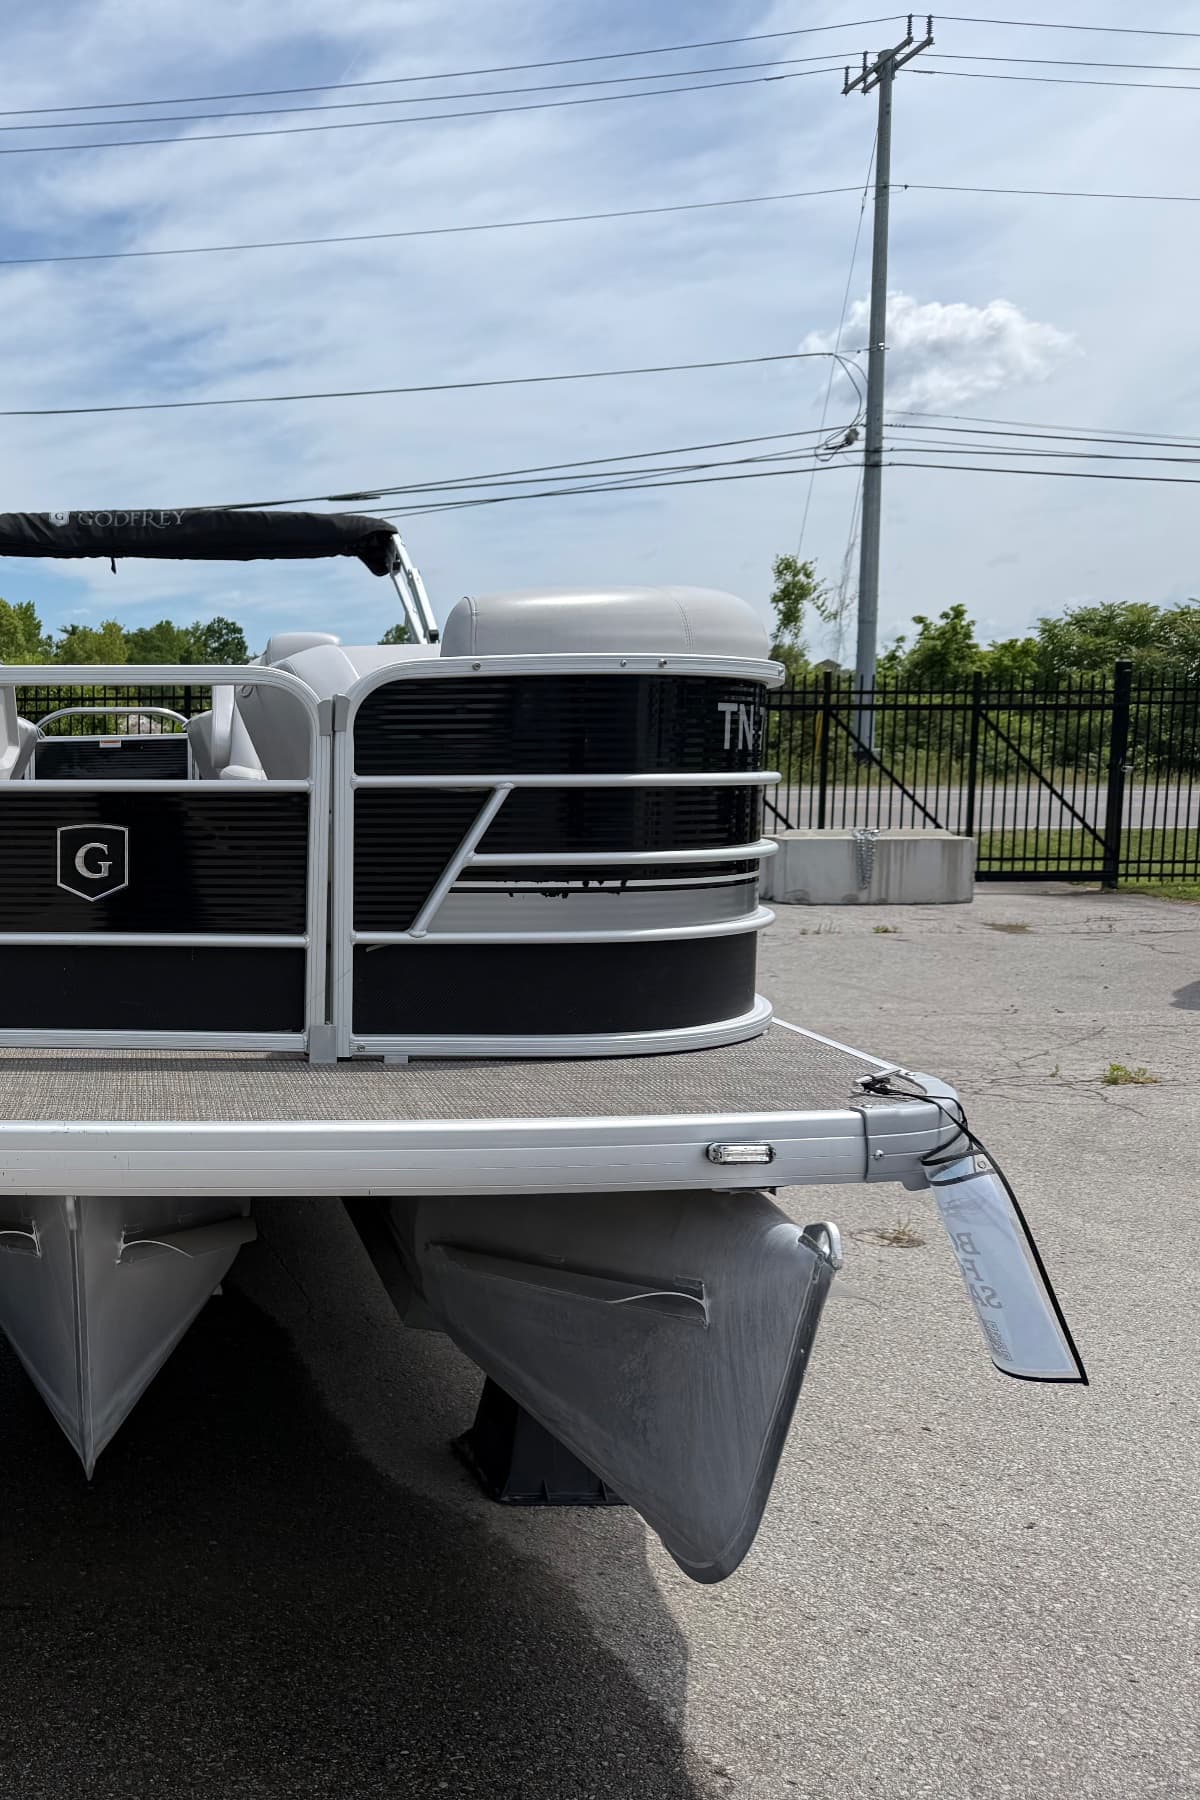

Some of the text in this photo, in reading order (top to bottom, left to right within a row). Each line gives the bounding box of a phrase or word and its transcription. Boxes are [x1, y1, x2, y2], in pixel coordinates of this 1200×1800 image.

[79, 511, 186, 528] GODFREY
[718, 702, 754, 750] TN
[74, 842, 113, 879] G
